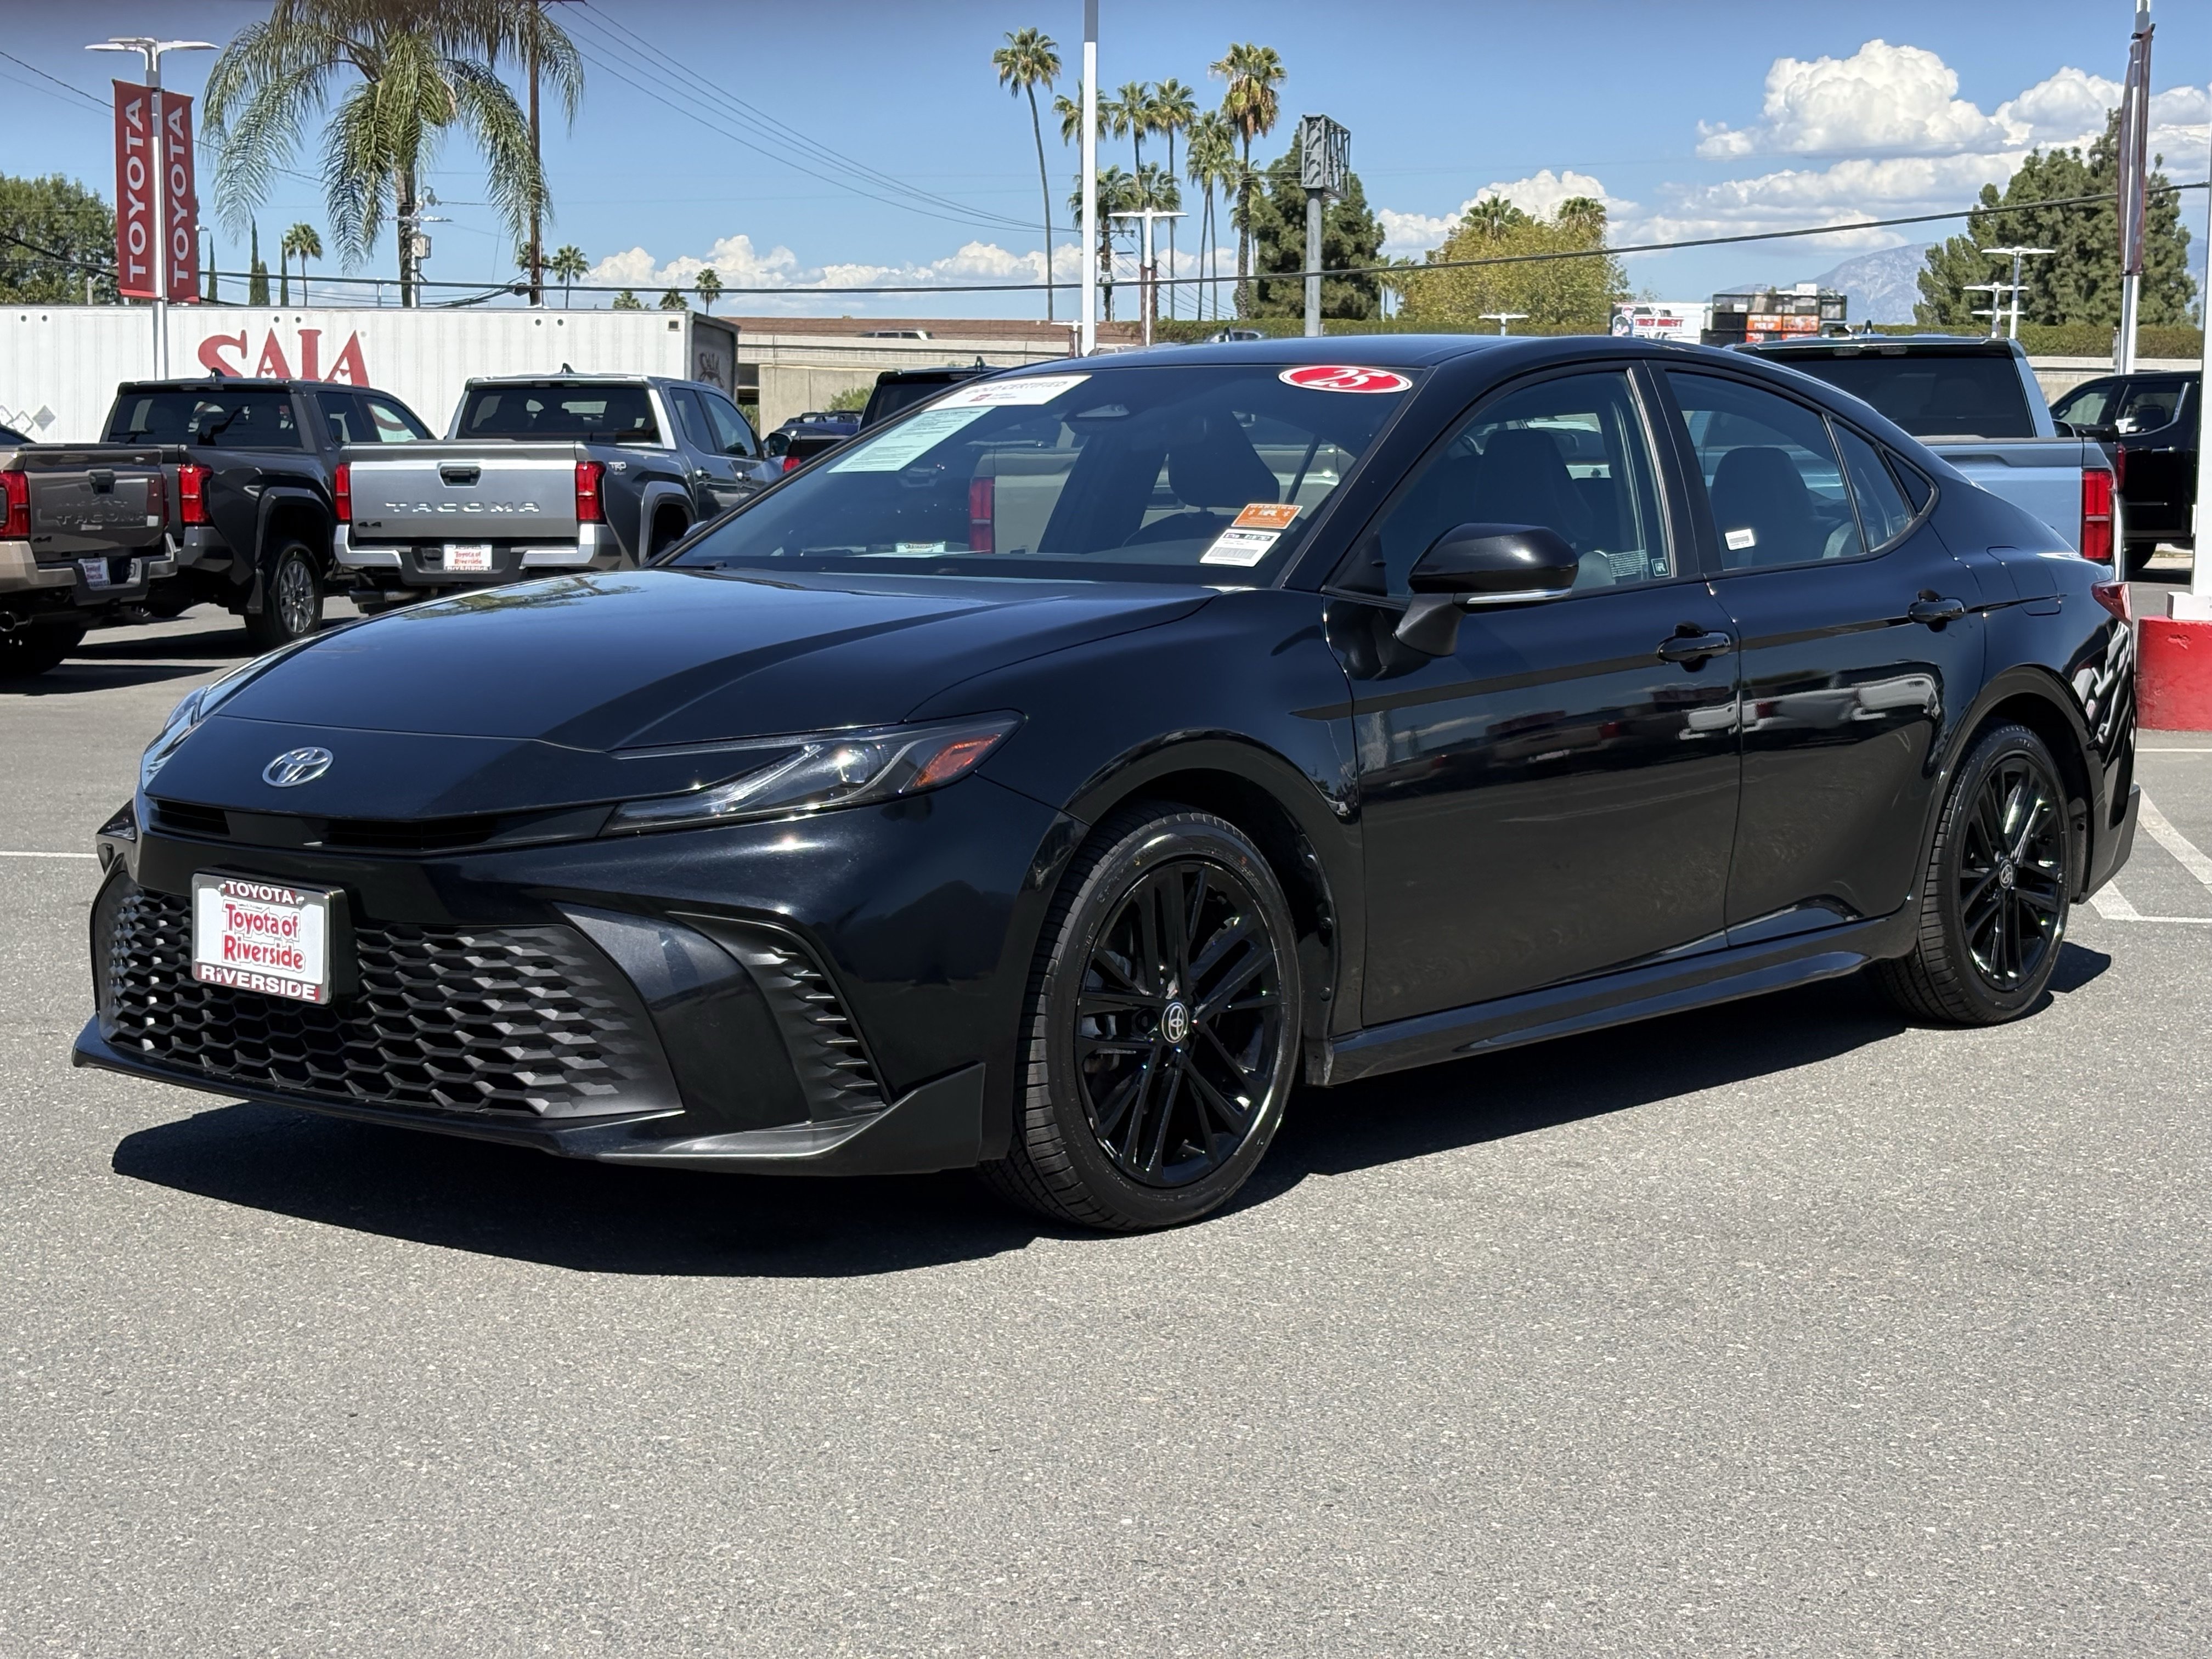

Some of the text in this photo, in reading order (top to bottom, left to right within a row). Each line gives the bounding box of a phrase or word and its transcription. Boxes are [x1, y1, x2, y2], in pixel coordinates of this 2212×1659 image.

[125, 98, 146, 283] TOYOTA
[168, 106, 189, 288] TOYOTA
[198, 328, 370, 388] SAIA
[1001, 381, 1068, 390] CERTIFIED
[1301, 369, 1391, 388] 25
[385, 501, 540, 513] TACOMA
[225, 880, 295, 905] TOYOTA
[225, 903, 298, 938] Toyota of
[223, 934, 304, 969] Riverside
[201, 964, 317, 1001] RIVERSIDE
